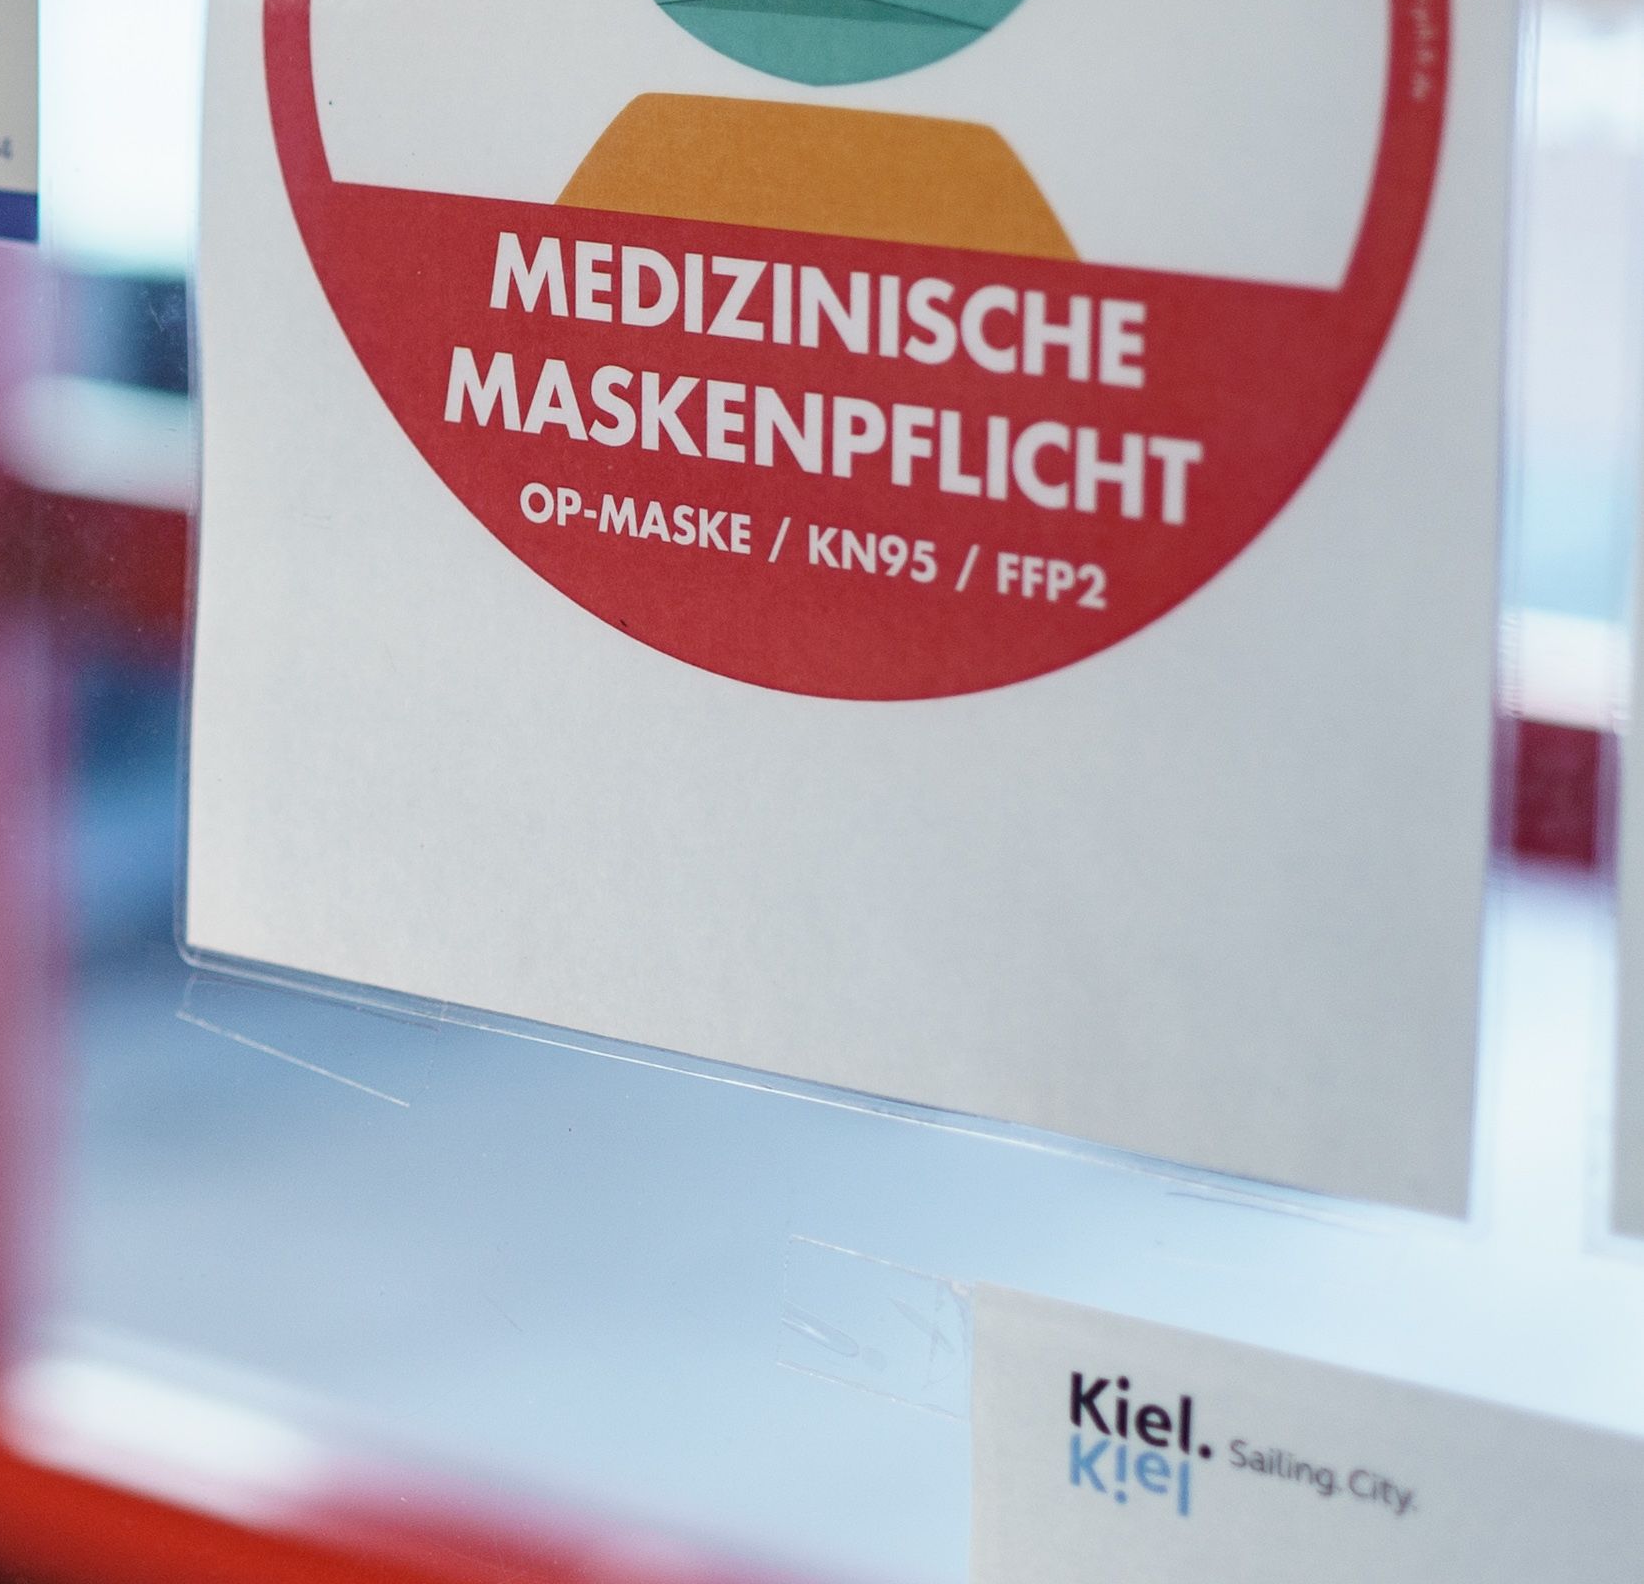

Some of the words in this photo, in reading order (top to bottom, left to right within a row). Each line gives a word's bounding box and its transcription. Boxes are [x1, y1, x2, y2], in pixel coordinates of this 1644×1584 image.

[489, 231, 1147, 389] MEDIZINISCHE
[444, 346, 1203, 526] MASKENPFLICHT
[520, 481, 752, 556] OP-MASKE
[768, 516, 791, 563] /
[808, 524, 938, 584] KN95
[955, 543, 980, 591] /
[997, 552, 1108, 610] FFP2
[1069, 1370, 1213, 1460] Kiel.
